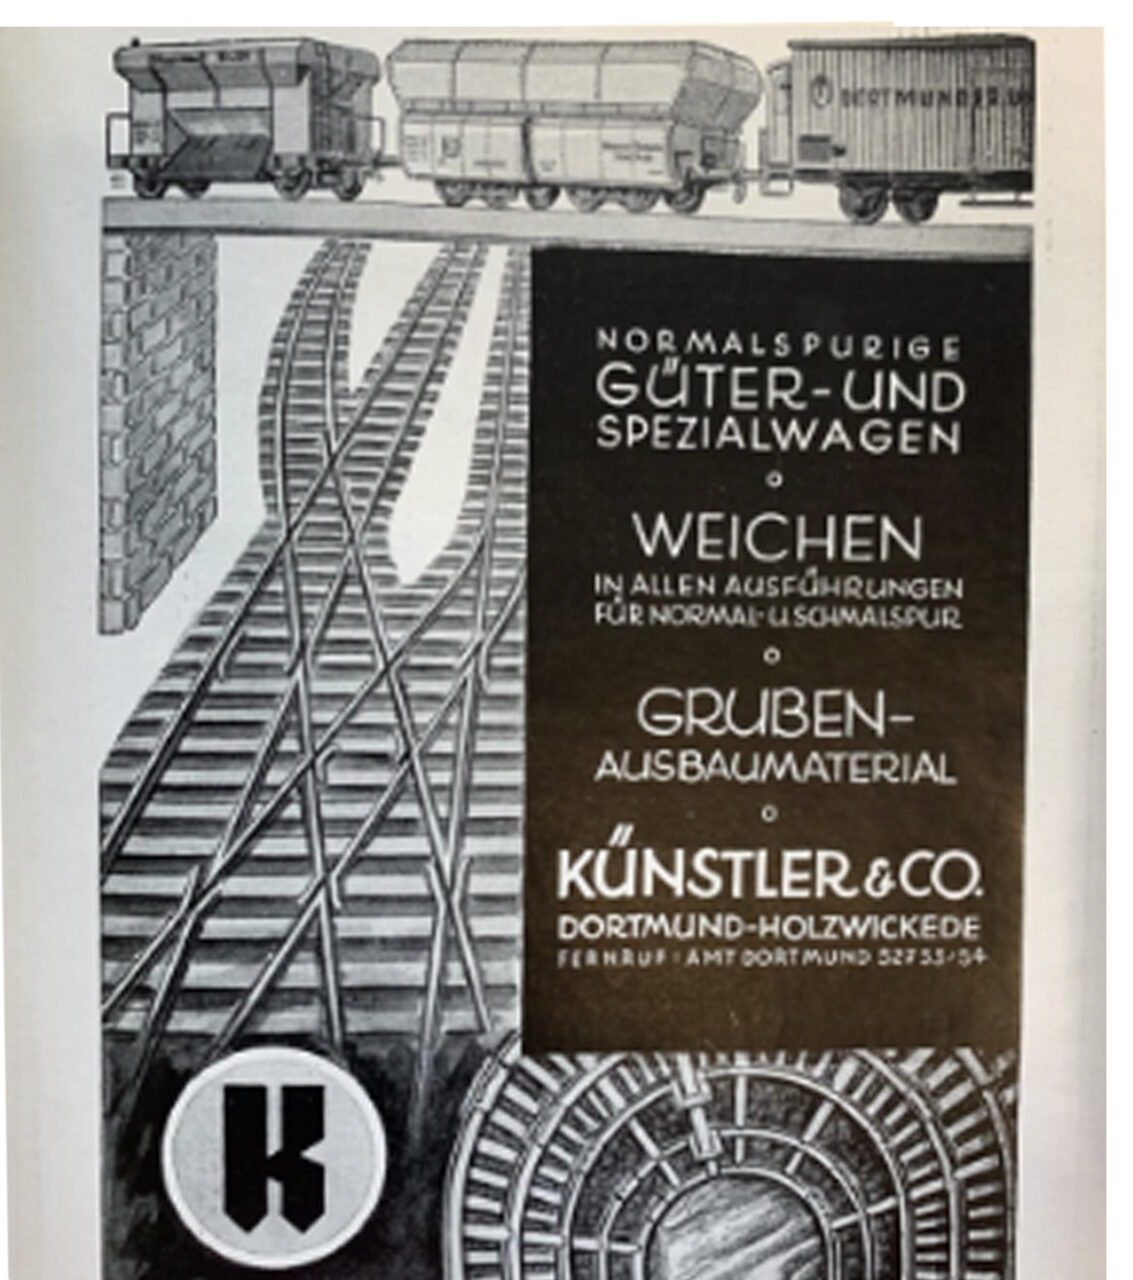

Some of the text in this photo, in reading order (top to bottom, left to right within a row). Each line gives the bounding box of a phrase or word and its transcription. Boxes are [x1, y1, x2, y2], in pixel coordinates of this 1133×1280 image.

[597, 327, 960, 362] NORMALSPURIGE
[597, 414, 961, 455] SPEZIALWAGEN
[631, 512, 922, 561] WEICHEN
[594, 566, 964, 600] IN ALLEN AUSFÜHRUNGEN
[594, 595, 643, 626] FÜR
[637, 686, 915, 738] GRUBEN-
[594, 748, 958, 785] AUSBAUMATERIAL
[557, 823, 985, 900] KÜNSTLER & CO.
[557, 947, 666, 969] FERNRUF
[686, 946, 737, 967] AMT
[741, 947, 872, 967] DORTMUND
[222, 1084, 325, 1234] K
